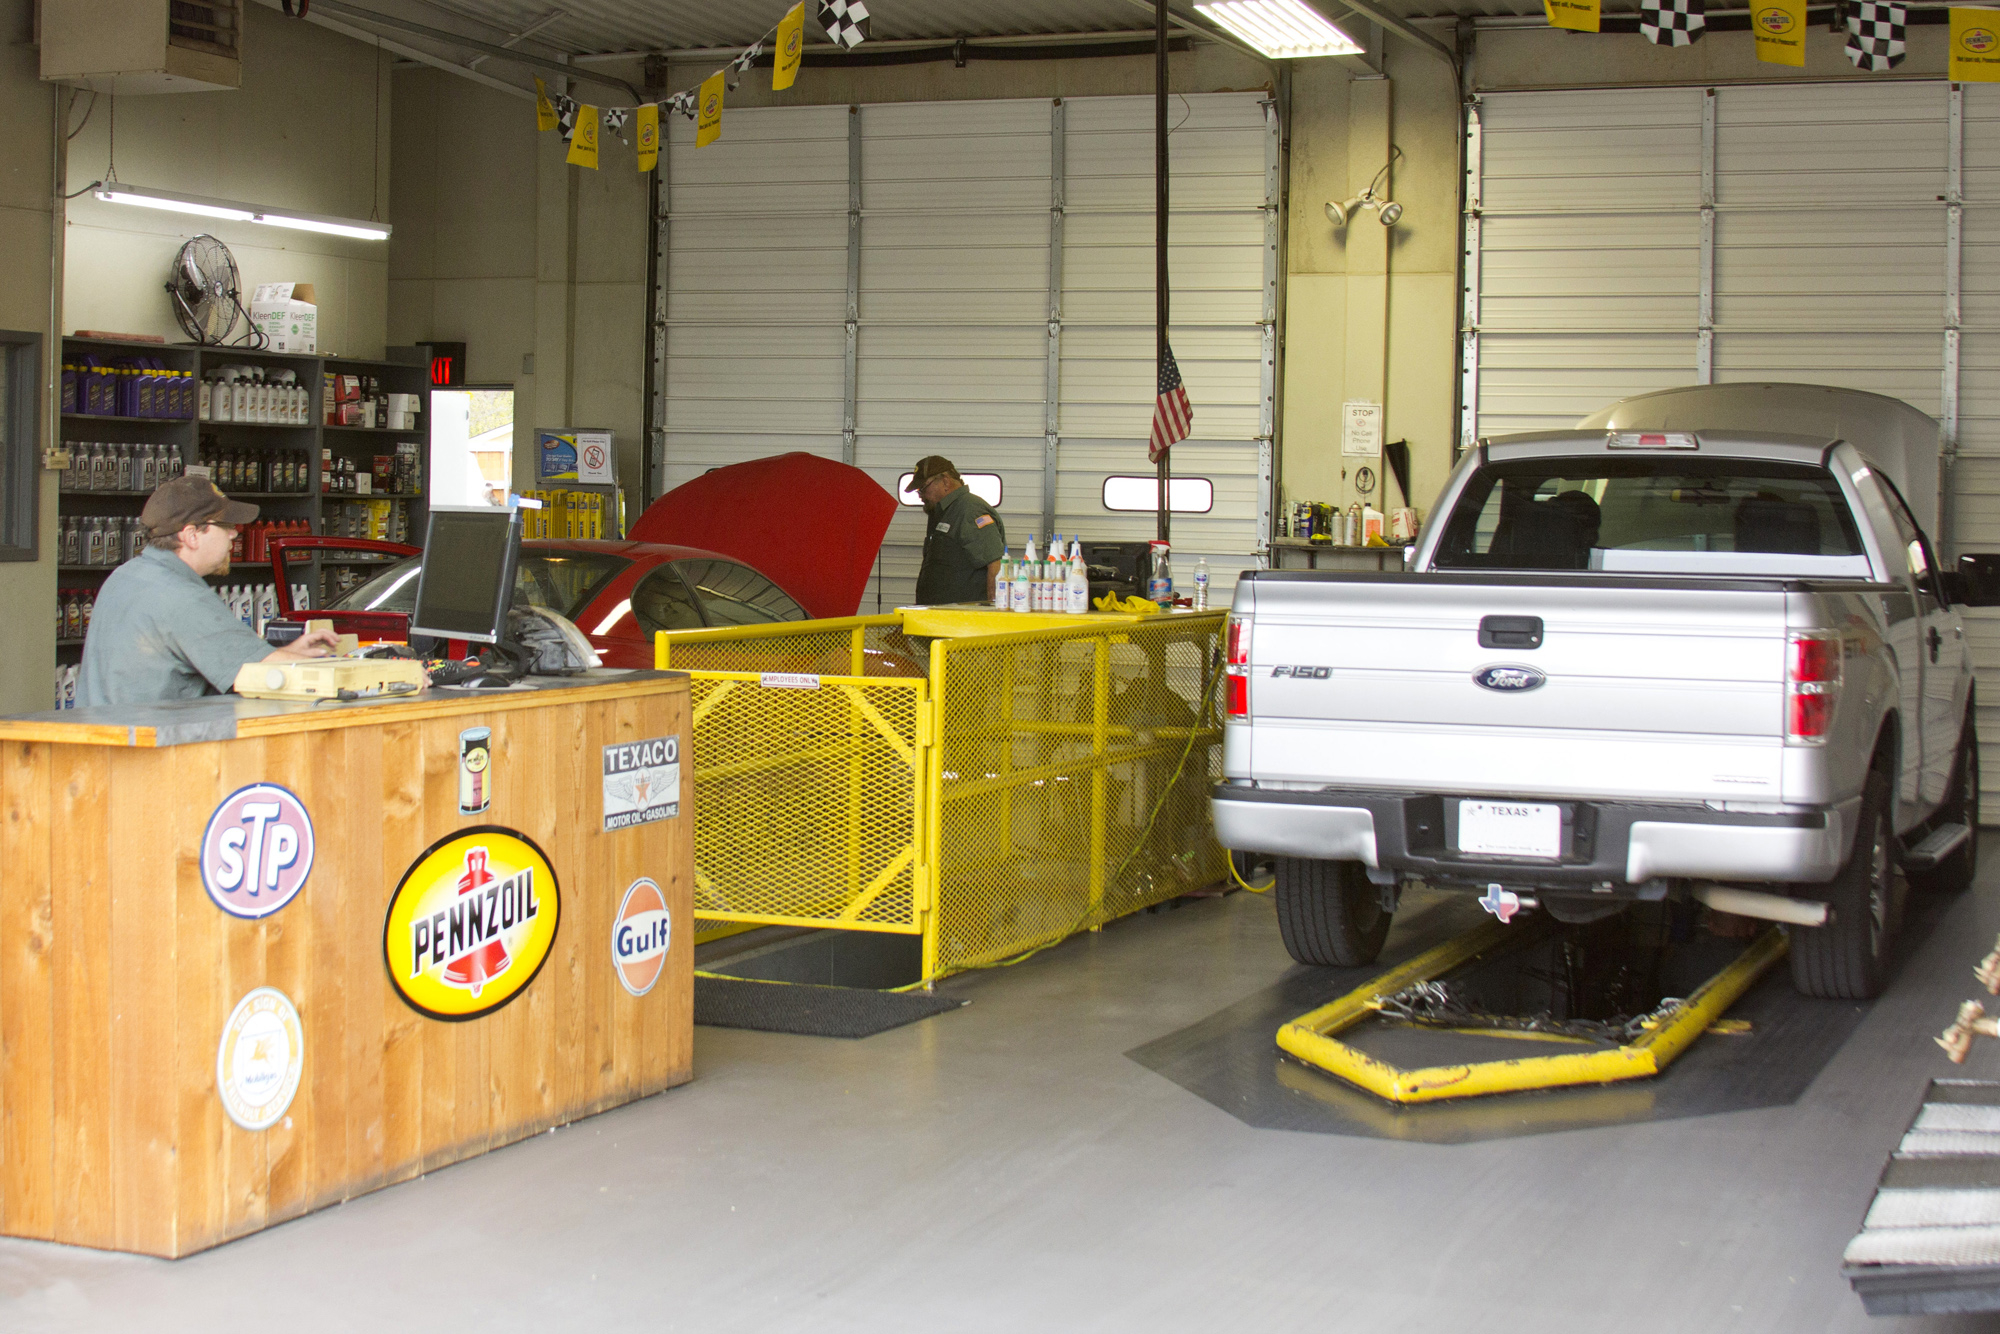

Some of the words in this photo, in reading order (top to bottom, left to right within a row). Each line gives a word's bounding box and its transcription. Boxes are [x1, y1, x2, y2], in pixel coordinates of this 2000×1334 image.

[252, 312, 286, 320] KleenDEF
[290, 312, 315, 321] KleenDEF
[431, 357, 452, 384] XIT
[765, 675, 798, 683] EMPLOYEES
[1270, 664, 1332, 680] F-150
[1487, 668, 1528, 688] Ford
[606, 739, 677, 772] TEXACO
[607, 815, 631, 828] MOTOR
[632, 812, 642, 824] OIL
[646, 804, 676, 820] GASOLINE
[1491, 806, 1528, 816] TEXAS
[216, 802, 300, 896] STP
[414, 869, 538, 974] PENNZOIL
[617, 918, 667, 957] Gulf
[254, 995, 276, 1011] SIGN
